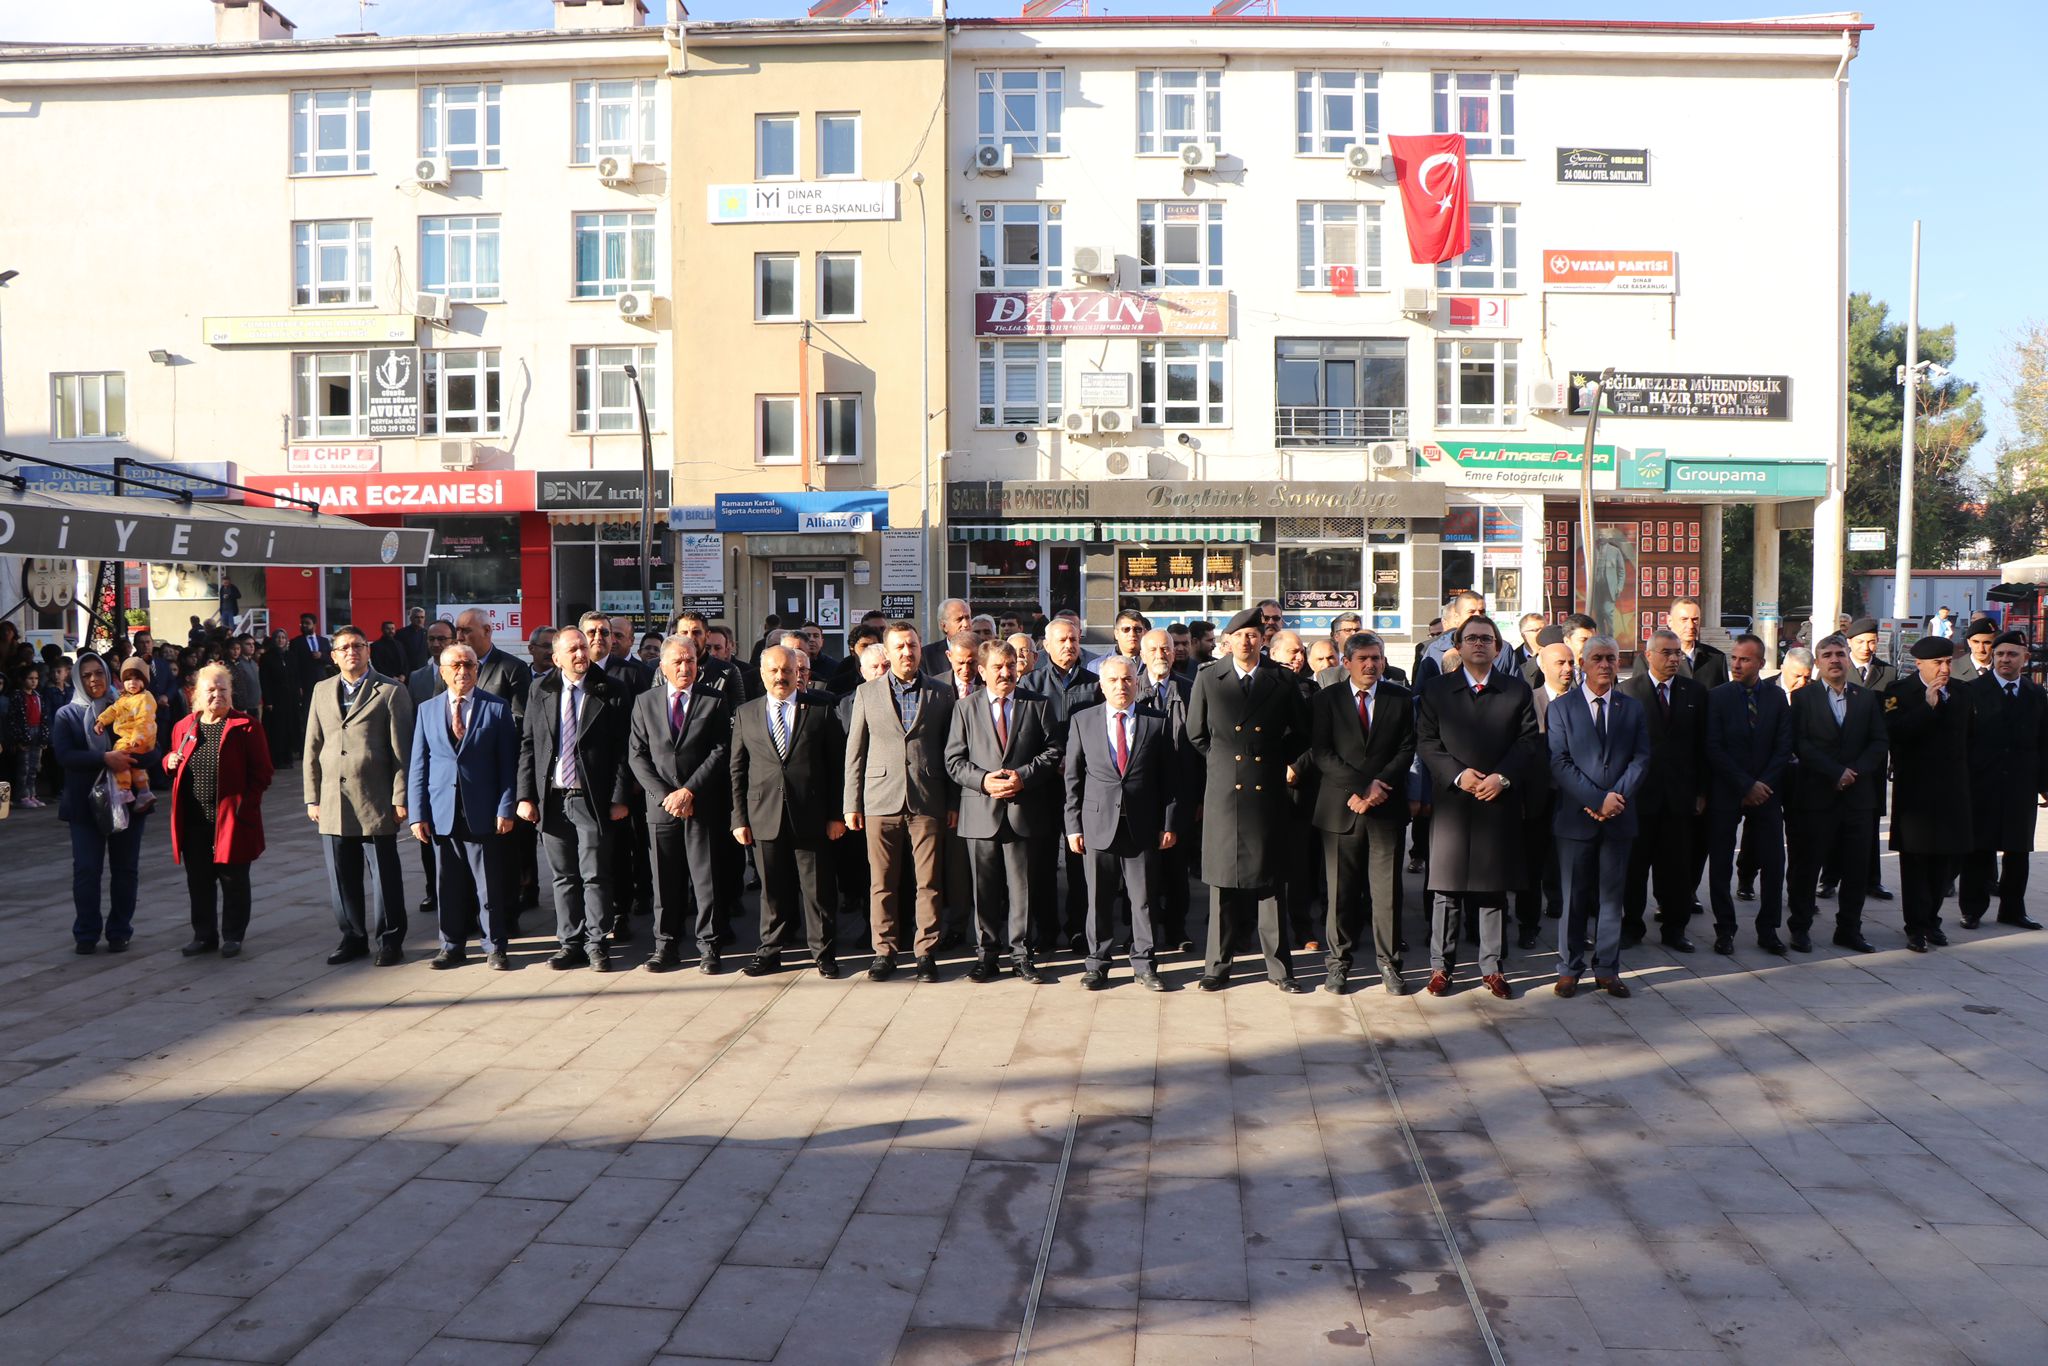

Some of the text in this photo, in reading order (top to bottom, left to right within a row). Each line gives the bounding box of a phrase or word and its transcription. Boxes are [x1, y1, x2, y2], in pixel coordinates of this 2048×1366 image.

[1564, 169, 1644, 181] 24 ODALI OTEL SATILIKTIR
[787, 189, 822, 200] DİNAR
[787, 203, 814, 217] İLÇE
[815, 201, 884, 216] BAŞKANLIĞI
[1570, 260, 1615, 272] VATAN
[986, 296, 1148, 323] DAYAN
[1605, 374, 1782, 393] EĞİLMEZLER MÜHENDİSLİK
[1649, 391, 1691, 405] HAZIR
[1694, 392, 1738, 406] BETON
[370, 404, 418, 418] AVUKAT
[1617, 403, 1648, 414] Plan
[1663, 404, 1699, 416] Proje
[1713, 404, 1769, 416] Taahhüt
[314, 447, 351, 461] CHP
[1465, 470, 1564, 484] Emre Fotoğrafçılık
[1676, 466, 1767, 484] Groupama
[274, 479, 503, 508] DİNAR ECZANESİ
[543, 480, 604, 501] DENİZ
[753, 499, 775, 507] Kartal
[1014, 484, 1089, 514] BÖREKÇİSİ
[1146, 485, 1259, 513] Baştürk
[721, 507, 783, 516] Sigorta Acenteliği
[805, 516, 847, 529] Allianz
[509, 613, 520, 626] E
